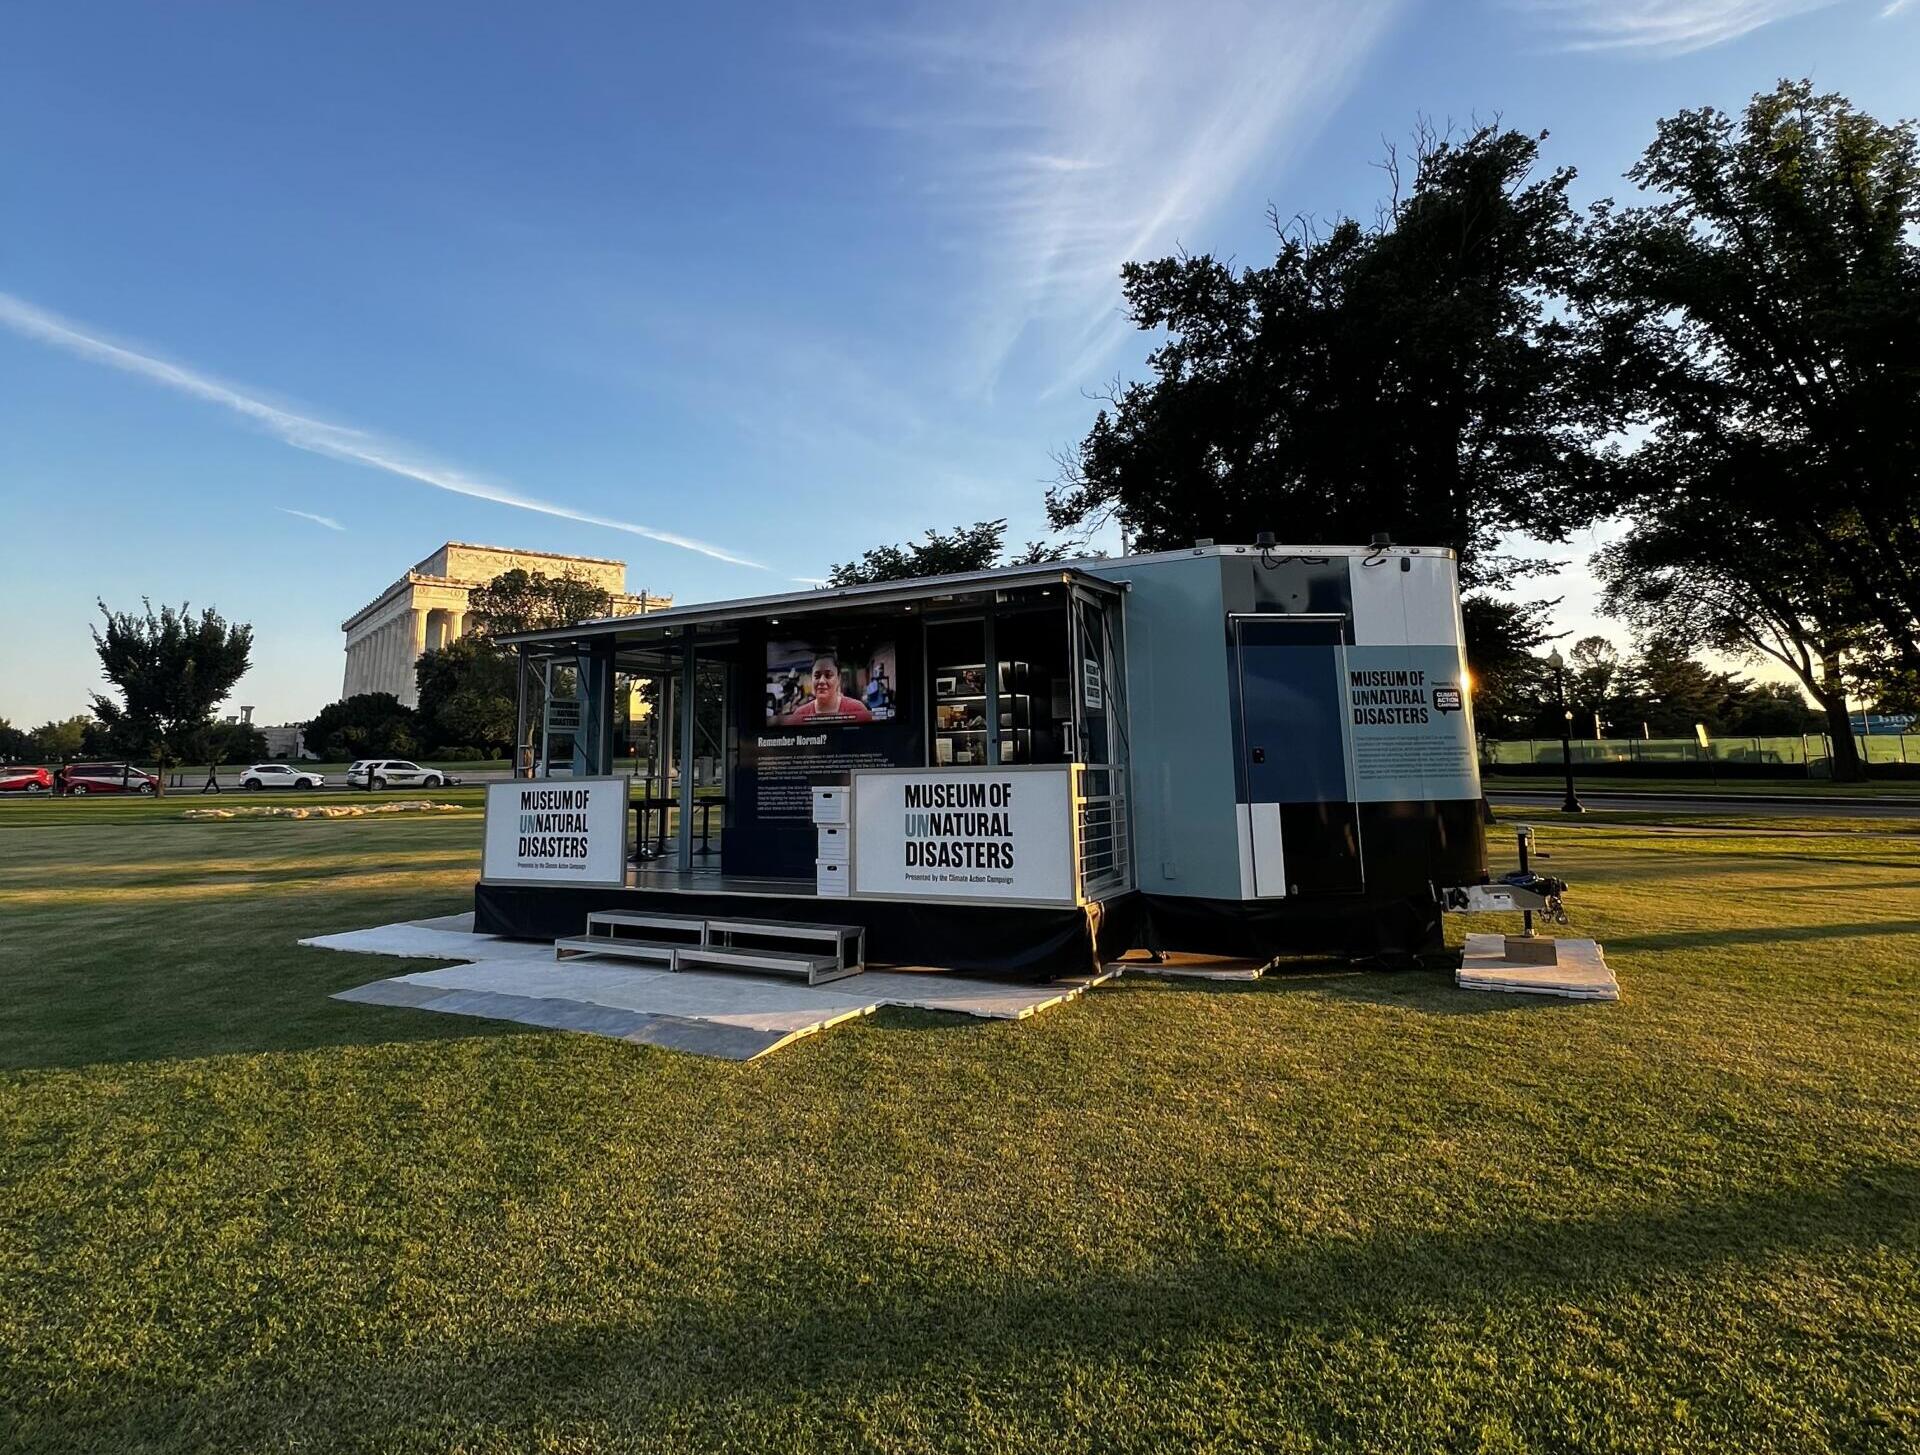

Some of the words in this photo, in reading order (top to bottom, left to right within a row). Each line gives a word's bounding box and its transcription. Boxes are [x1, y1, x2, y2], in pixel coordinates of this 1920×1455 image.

[1351, 671, 1408, 687] MUSEUM
[1410, 671, 1424, 686] OF
[1352, 689, 1427, 706] UNNATURAL
[1354, 707, 1428, 724] DISASTERS
[758, 736, 795, 747] Remember
[796, 734, 827, 746] Normal?
[521, 790, 573, 810] MUSEUM
[576, 790, 590, 810] OF
[905, 784, 986, 808] MUSEUM
[990, 783, 1012, 807] OF
[520, 814, 588, 834] UNNATURAL
[905, 814, 1013, 837] UNNATURAL
[519, 836, 588, 858] DISASTERS
[906, 842, 1014, 869] DISASTERS
[905, 873, 930, 881] Presented
[932, 874, 938, 882] by
[949, 874, 968, 882] Climate
[987, 876, 1014, 884] Campaign
